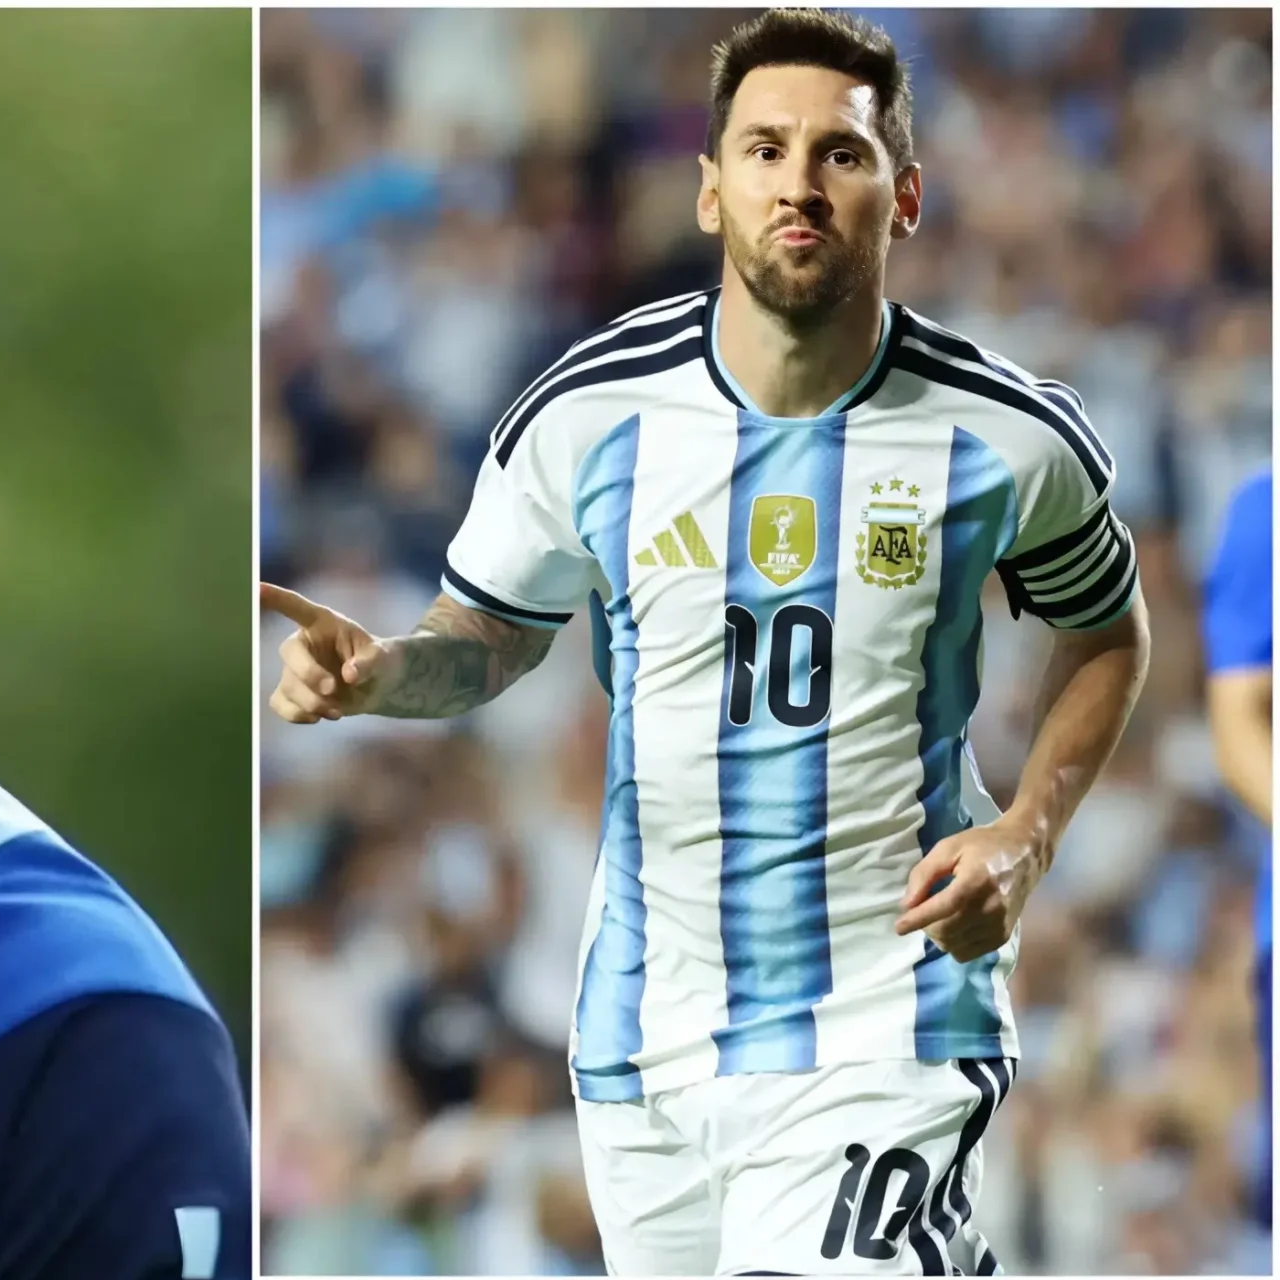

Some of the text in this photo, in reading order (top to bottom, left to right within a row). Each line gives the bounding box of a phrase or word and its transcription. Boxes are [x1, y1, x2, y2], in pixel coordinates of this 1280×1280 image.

[871, 525, 913, 565] AFA
[724, 603, 834, 727] 10
[820, 1143, 930, 1260] 10
